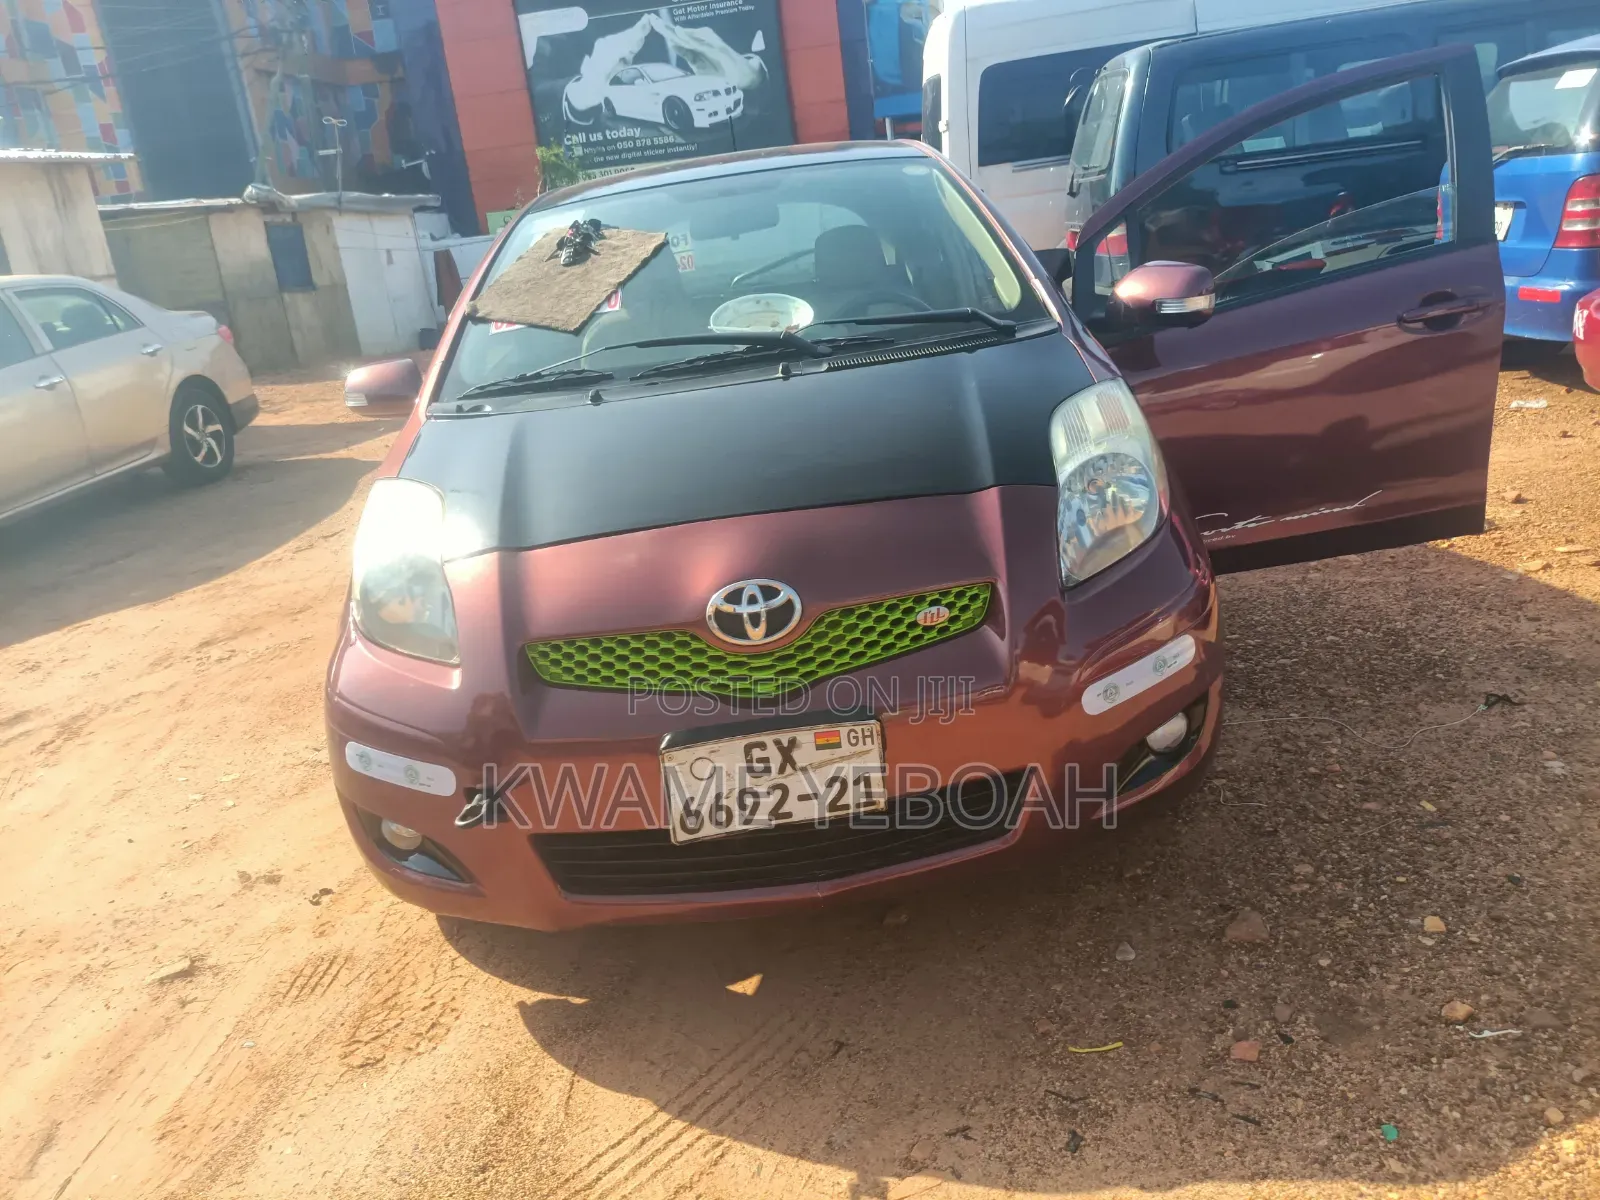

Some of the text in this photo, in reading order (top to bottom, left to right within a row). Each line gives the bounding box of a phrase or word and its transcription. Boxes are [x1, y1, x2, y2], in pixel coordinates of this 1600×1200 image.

[687, 5, 708, 13] Motor
[709, 0, 743, 9] Insurance
[564, 126, 641, 145] Call us today
[616, 140, 634, 150] 050
[636, 138, 652, 147] 878
[653, 135, 675, 145] 5586
[605, 153, 620, 161] new
[621, 149, 642, 160] digital
[643, 147, 665, 157] sticker
[743, 726, 875, 779] GX GH
[679, 771, 878, 836] 6692-21
